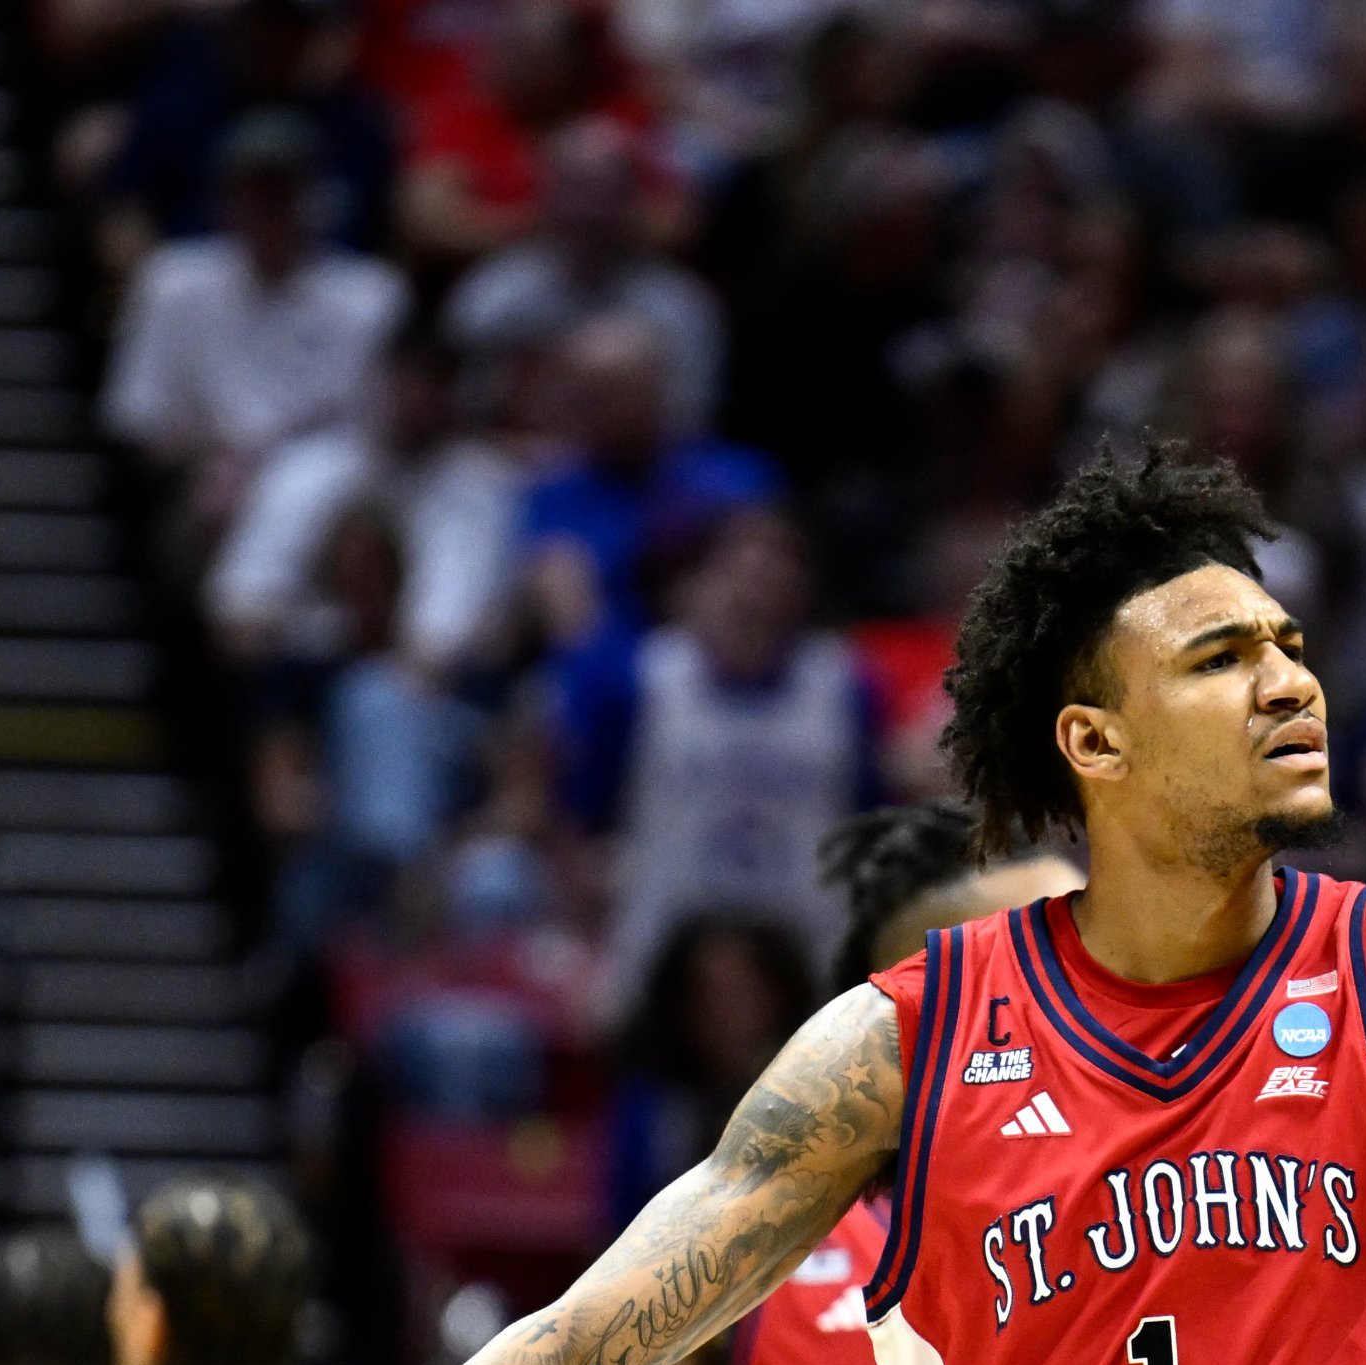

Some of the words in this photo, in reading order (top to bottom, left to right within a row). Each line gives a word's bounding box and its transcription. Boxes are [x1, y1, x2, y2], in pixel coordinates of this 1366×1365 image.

[987, 995, 1011, 1047] C
[1280, 1028, 1327, 1043] NCAA
[971, 1052, 995, 1068] BE
[999, 1048, 1030, 1067] THE
[963, 1063, 1032, 1083] CHANGE
[1268, 1066, 1318, 1080] BIG
[1260, 1079, 1329, 1094] EAST
[983, 1194, 1076, 1335] ST.
[1088, 1151, 1360, 1272] JOHN'S
